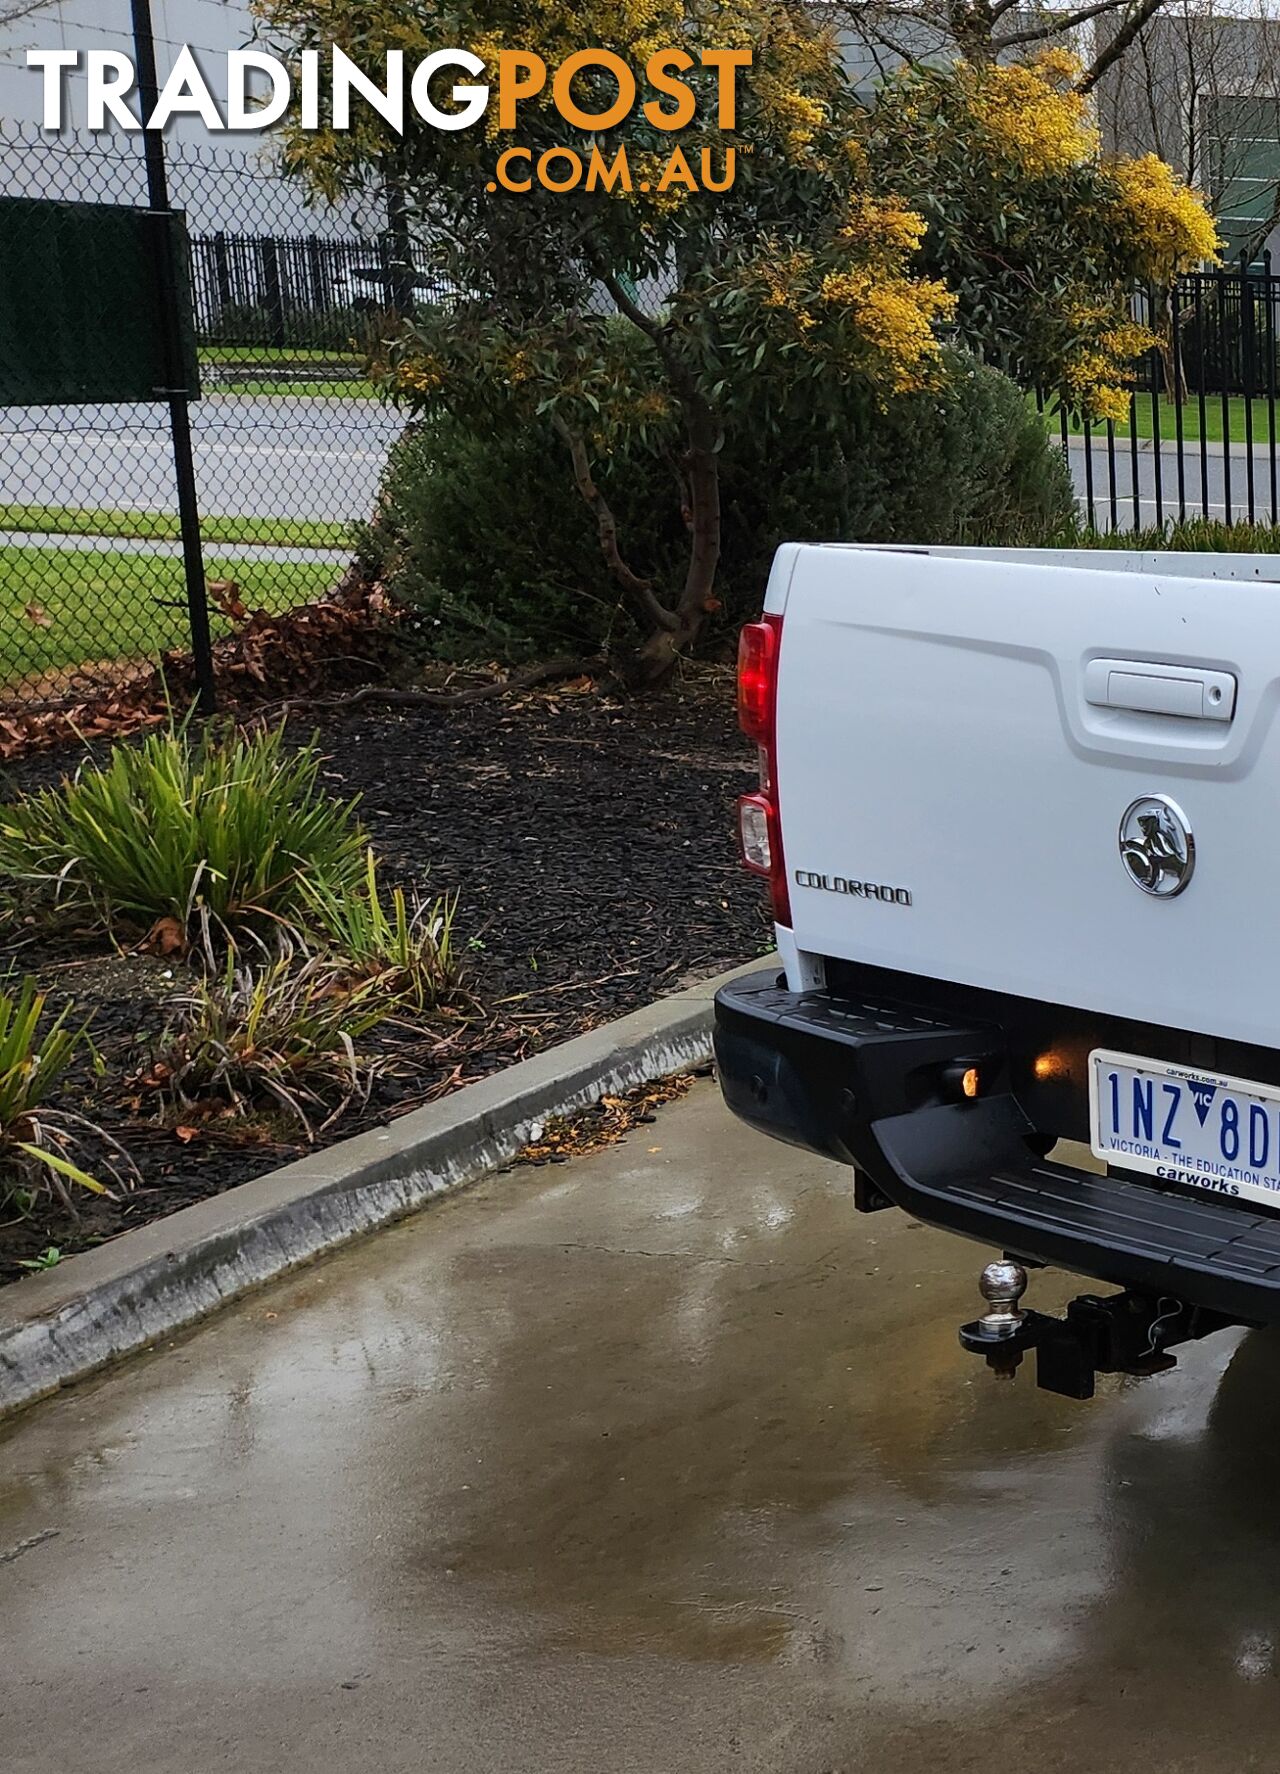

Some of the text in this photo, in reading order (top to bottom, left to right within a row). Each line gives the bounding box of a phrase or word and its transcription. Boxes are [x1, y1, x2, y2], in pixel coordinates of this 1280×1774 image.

[795, 870, 912, 906] COLORADO
[1166, 1067, 1228, 1087] carworks.com.au
[1108, 1071, 1182, 1149] 1NZ
[1192, 1091, 1214, 1108] VIC
[1110, 1137, 1161, 1161] VICTORIA
[1171, 1152, 1193, 1169] THE
[1196, 1160, 1260, 1186] EDUCATION
[1156, 1165, 1240, 1195] carworks
